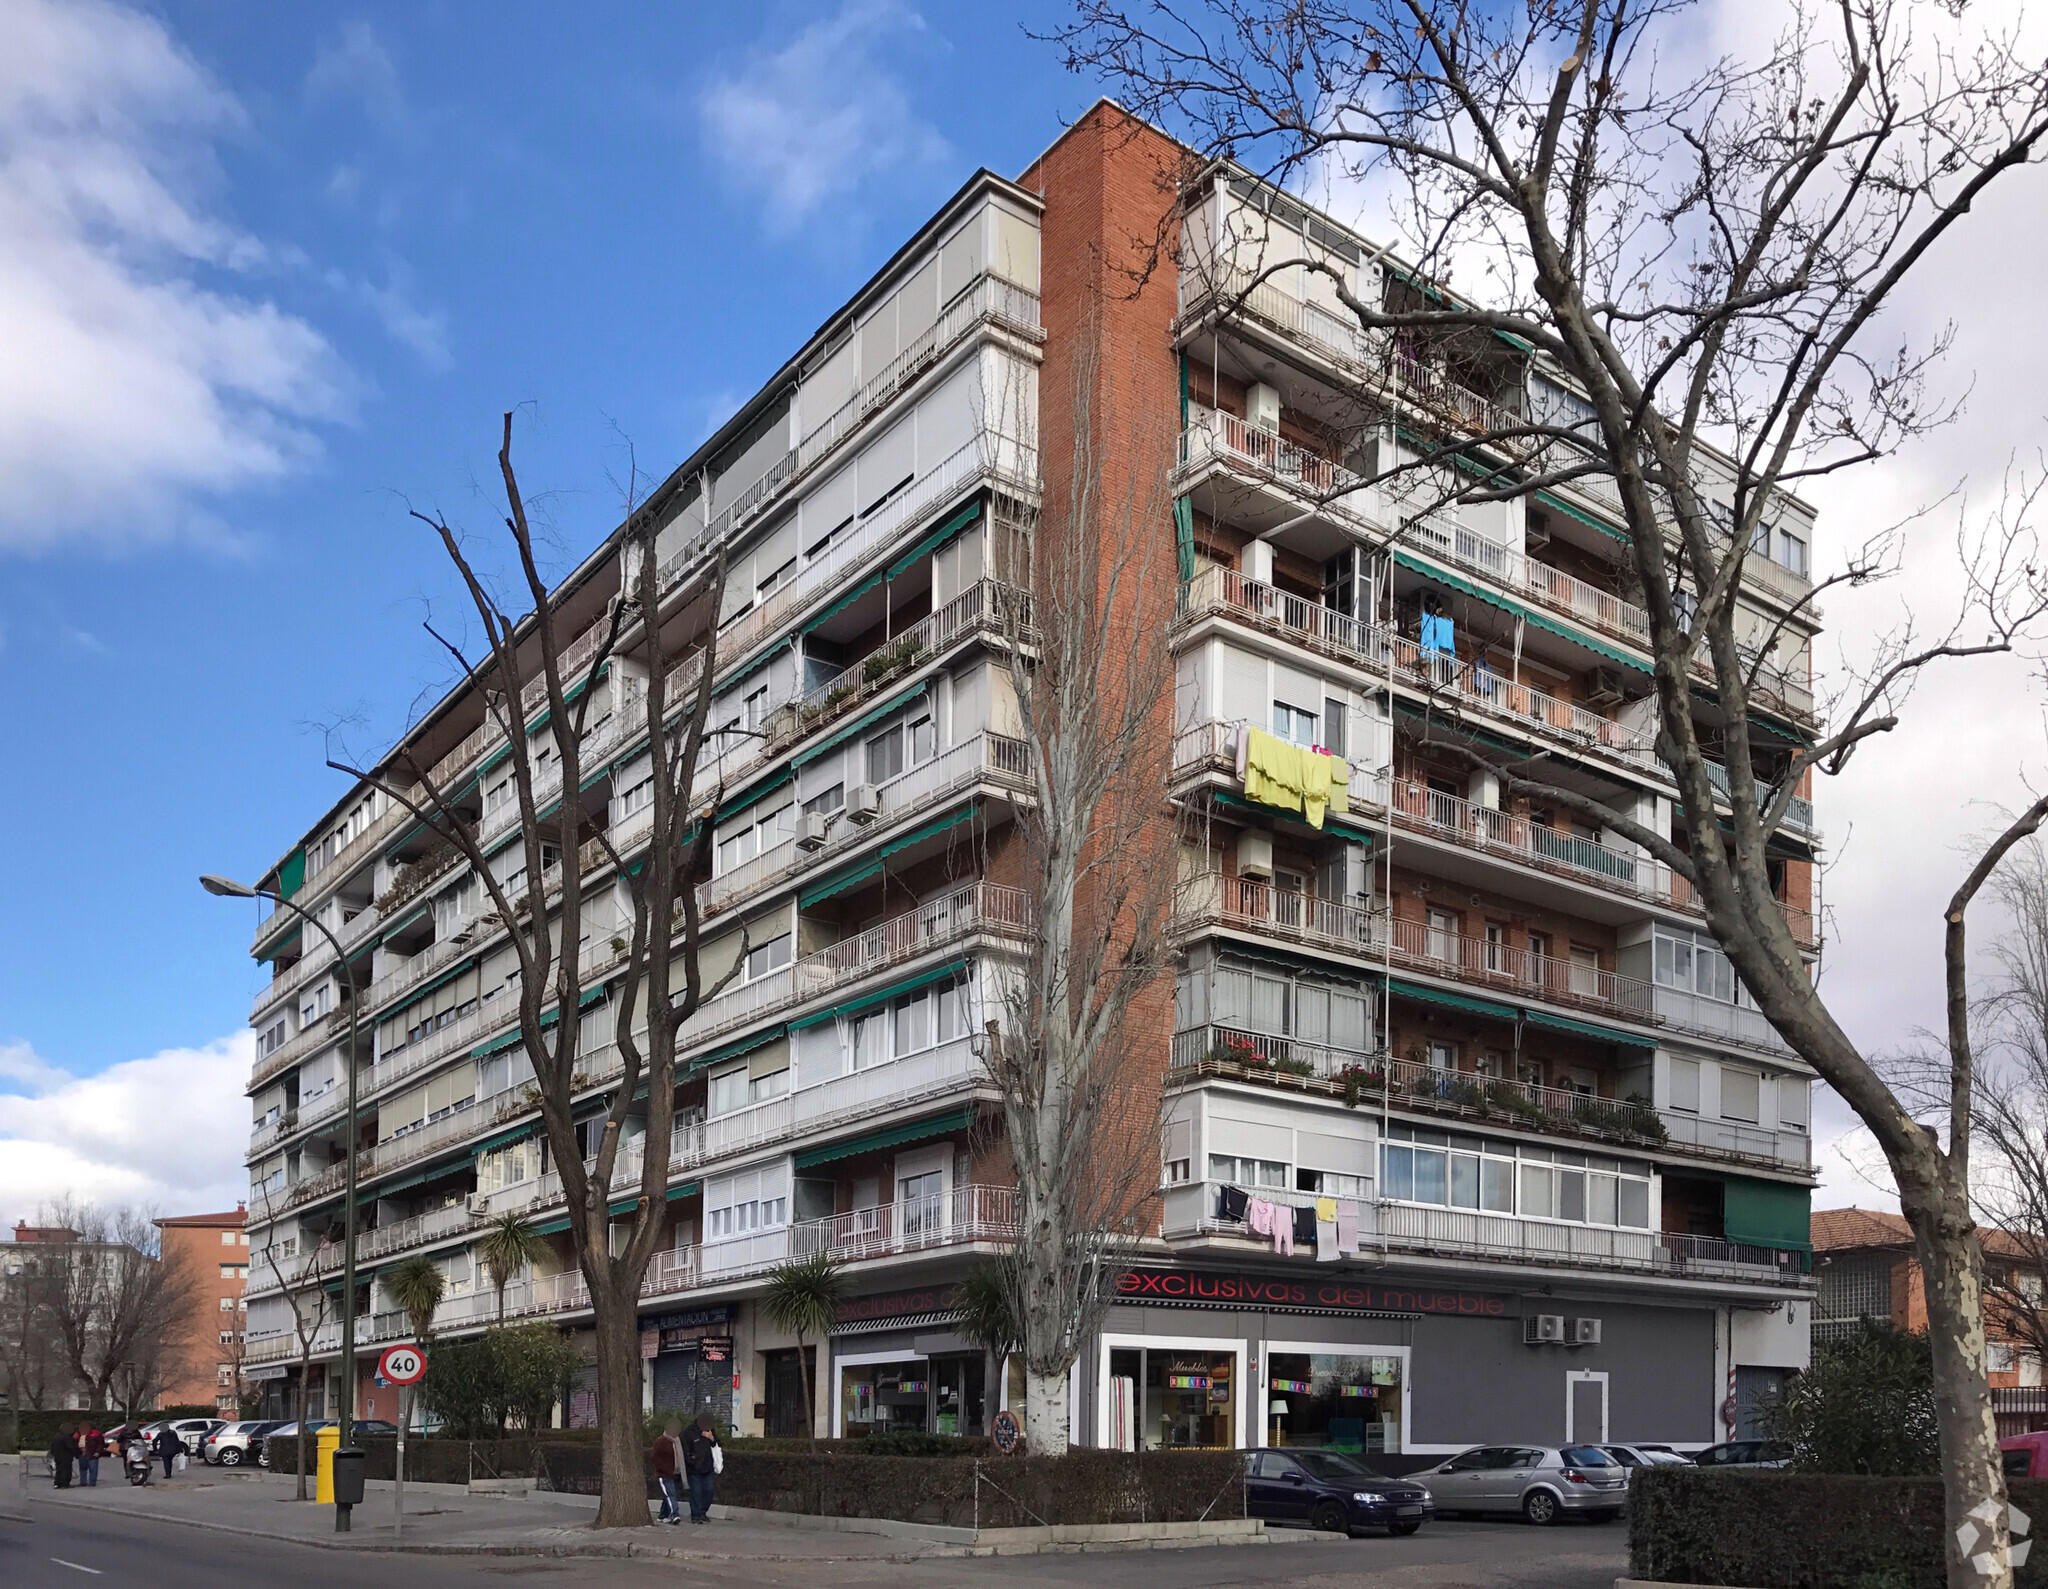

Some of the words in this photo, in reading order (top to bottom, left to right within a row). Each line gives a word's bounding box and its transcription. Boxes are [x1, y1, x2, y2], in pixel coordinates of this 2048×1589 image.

[1114, 1272, 1306, 1301] exclusivas
[1318, 1285, 1372, 1305] del
[1383, 1290, 1505, 1314] mueble
[836, 1292, 934, 1320] exclusivas
[391, 1357, 415, 1372] 40
[1169, 1360, 1208, 1373] Muebles
